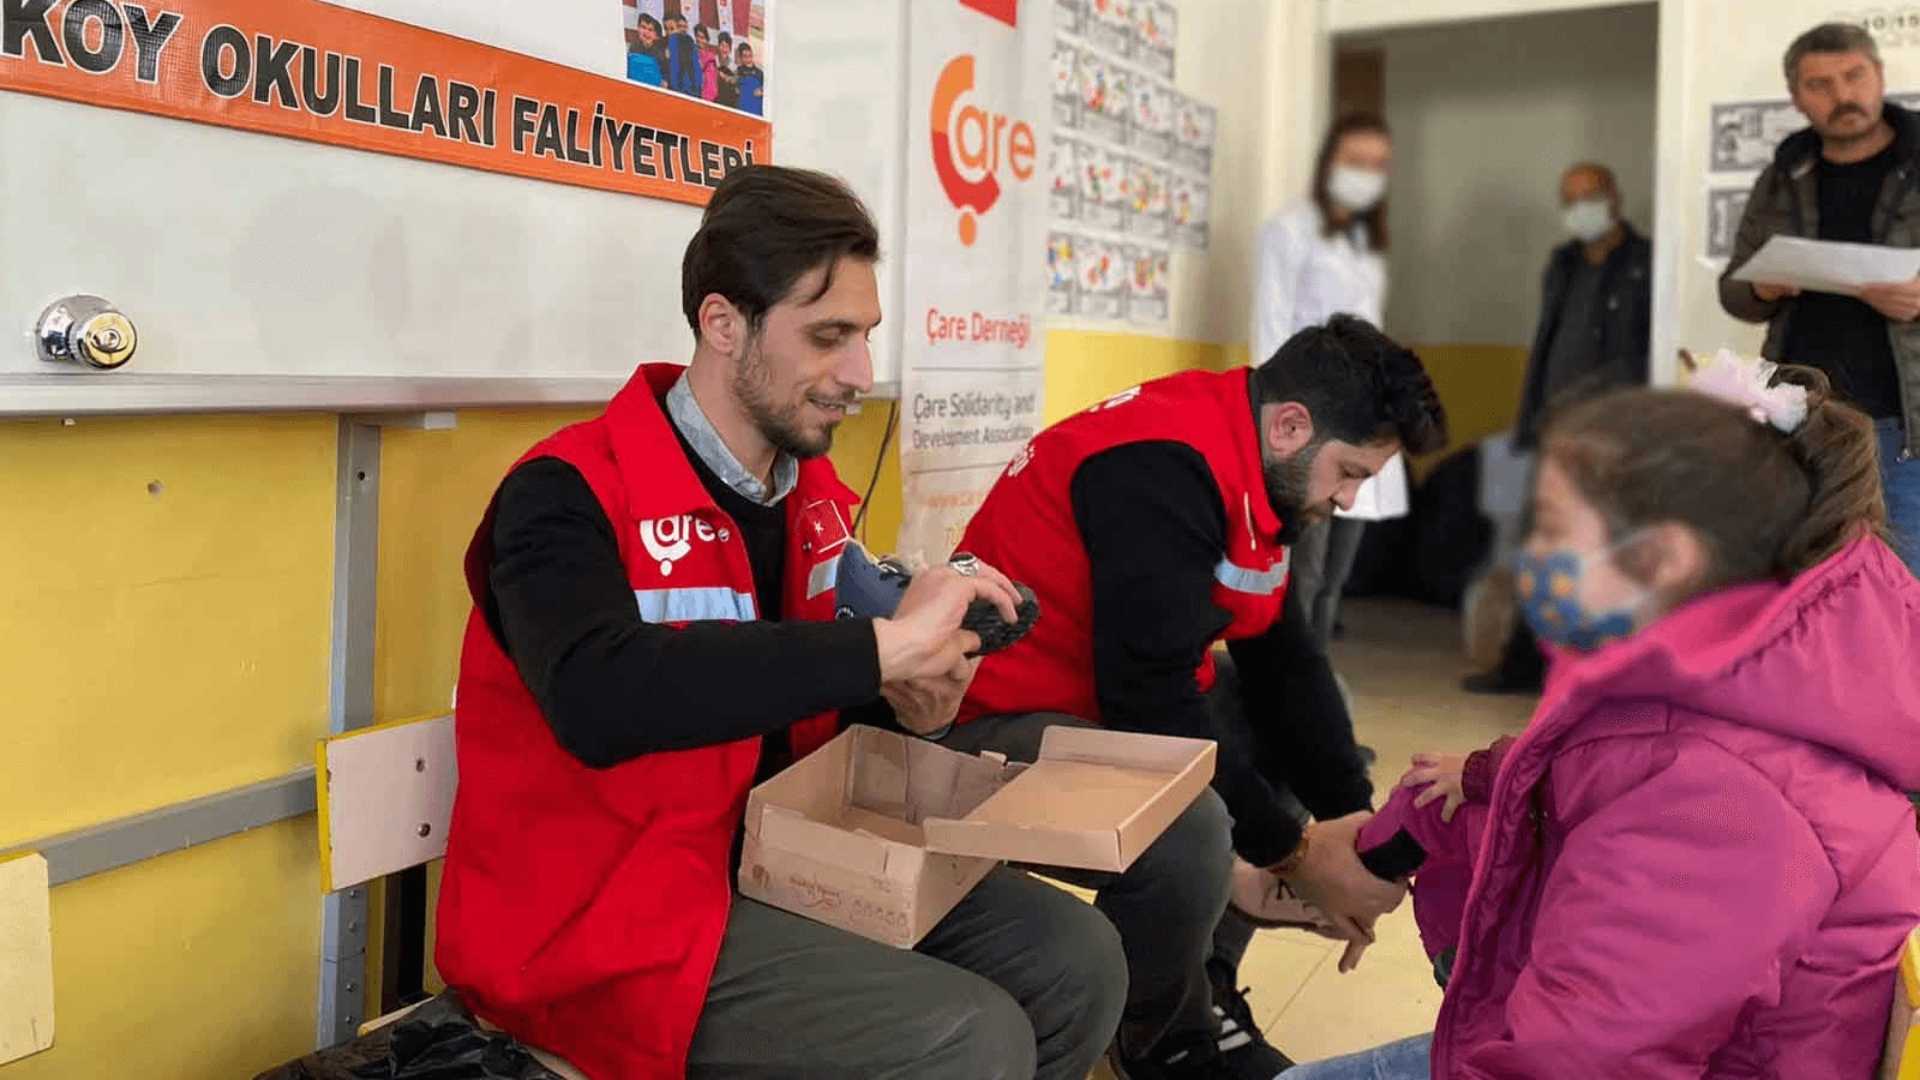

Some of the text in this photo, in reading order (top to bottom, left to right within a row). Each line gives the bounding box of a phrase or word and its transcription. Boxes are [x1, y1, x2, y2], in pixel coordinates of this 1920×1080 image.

[201, 24, 497, 147] OKULLARI
[927, 308, 1031, 349] Çare Derneği
[913, 390, 1035, 424] Çare Solidarity and
[912, 428, 980, 450] Development
